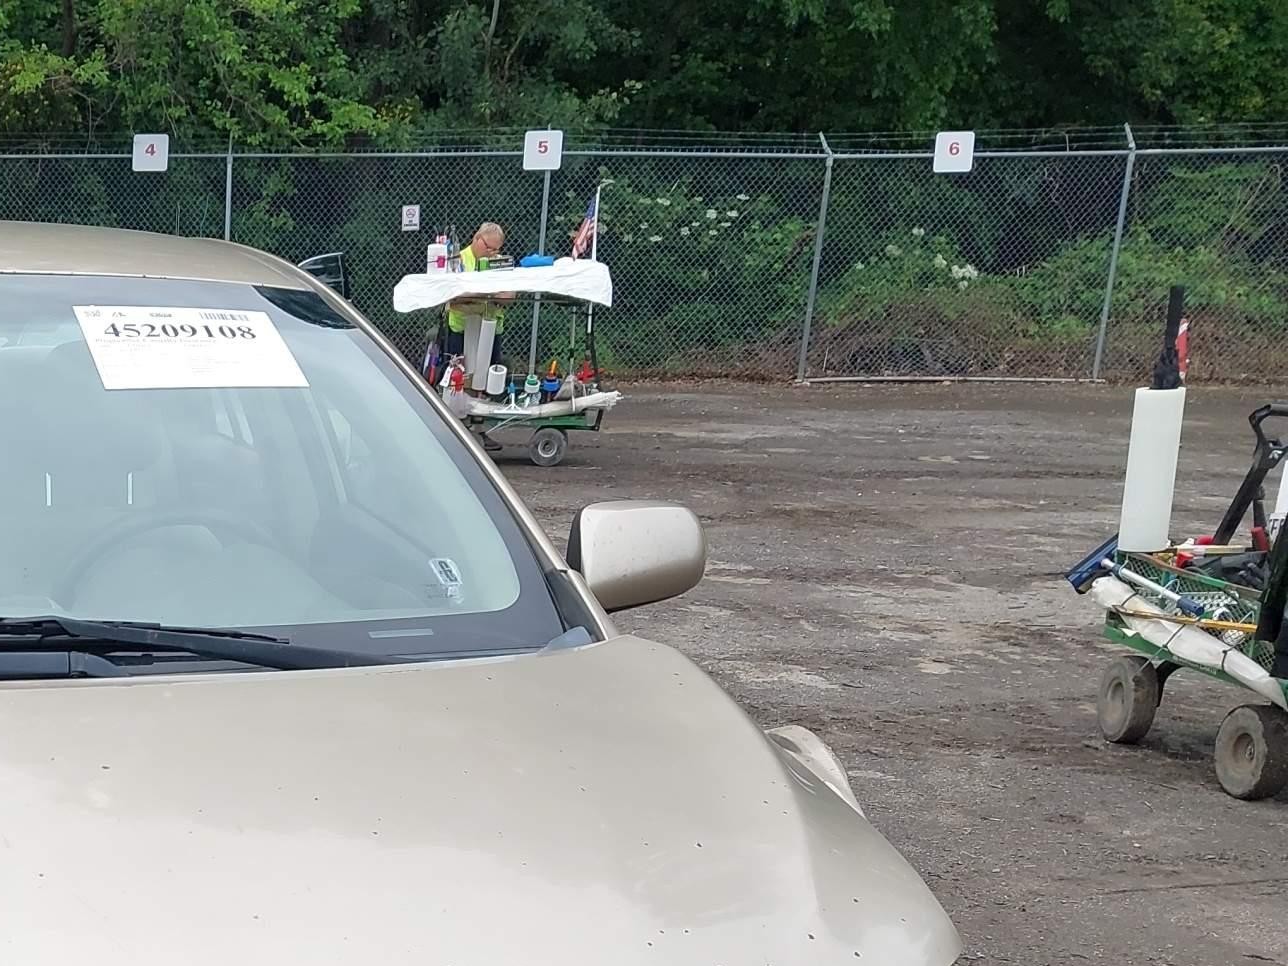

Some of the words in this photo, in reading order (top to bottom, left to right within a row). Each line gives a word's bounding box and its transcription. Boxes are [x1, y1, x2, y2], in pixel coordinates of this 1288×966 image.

[144, 143, 156, 157] 4
[537, 140, 549, 154] 5
[948, 141, 960, 156] 6
[104, 322, 257, 341] 45209108
